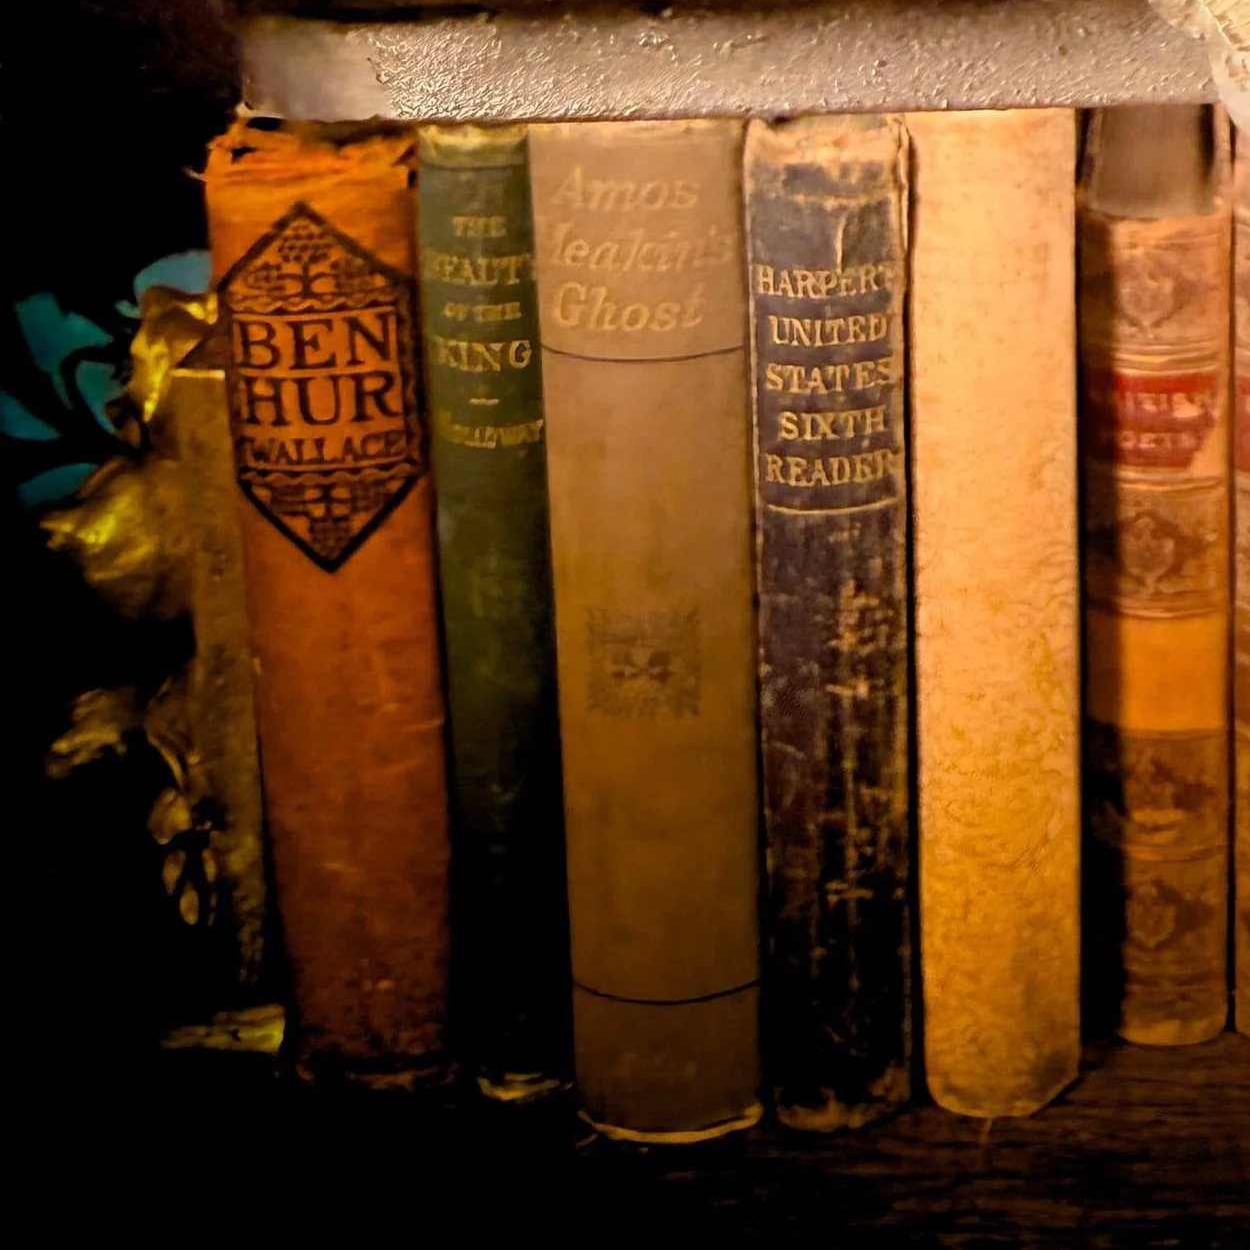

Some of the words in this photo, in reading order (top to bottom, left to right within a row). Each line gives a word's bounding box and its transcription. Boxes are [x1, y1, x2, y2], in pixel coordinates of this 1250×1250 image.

[552, 165, 700, 212] Amos
[553, 281, 706, 332] Ghost
[238, 313, 391, 369] BEN
[768, 315, 888, 346] UNITED
[765, 358, 893, 394] STATES
[243, 371, 402, 426] HUR
[778, 405, 887, 441] SIXTH
[765, 451, 897, 487] READER
